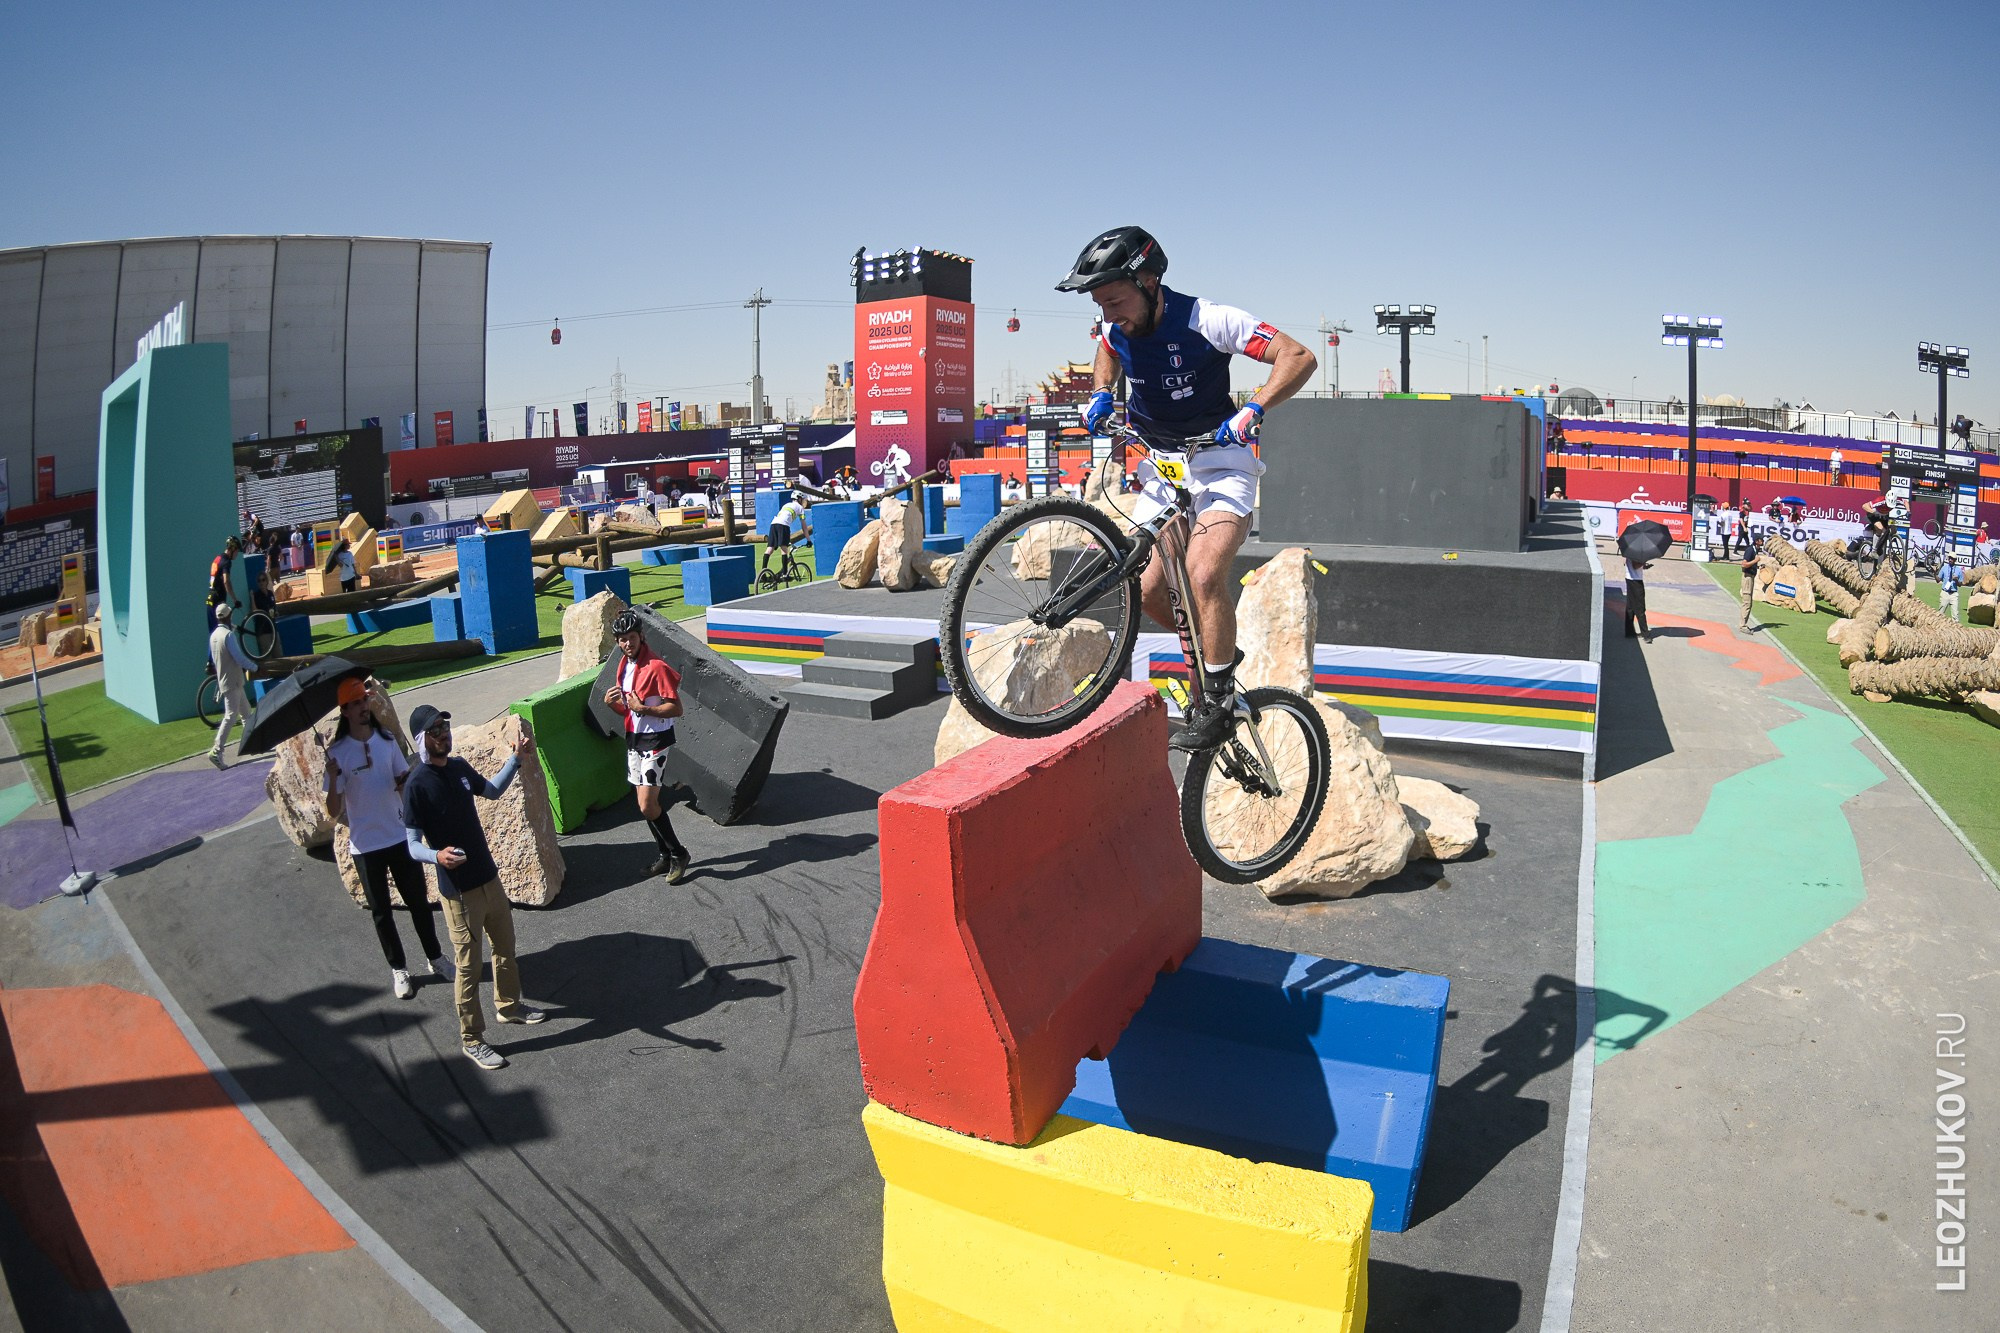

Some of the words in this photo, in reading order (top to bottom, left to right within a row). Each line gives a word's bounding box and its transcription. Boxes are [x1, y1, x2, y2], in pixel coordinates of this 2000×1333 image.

[1129, 253, 1146, 271] URGE
[869, 309, 912, 326] RIYADH
[936, 308, 966, 325] RIYADH
[137, 300, 184, 362] RIYADH
[869, 326, 892, 338] 2025
[894, 324, 912, 335] UCI
[936, 324, 953, 335] 2025
[953, 326, 966, 337] UCI
[869, 341, 912, 350] CHAMPIONSHIPS
[936, 341, 966, 350] CHAMPIONSHIPS
[555, 446, 579, 454] RIYADH
[1897, 449, 1911, 458] UCI
[1161, 464, 1177, 478] 23
[1925, 469, 1946, 479] FINISH
[432, 478, 449, 490] UCI
[1895, 478, 1908, 486] UCI
[1660, 500, 1688, 510] SAUD
[1698, 510, 1706, 519] 4
[1801, 507, 1834, 520] الرياضة
[1837, 508, 1860, 523] وزارة
[1750, 525, 1820, 543] TISSOT
[1230, 738, 1261, 771] VORTEX
